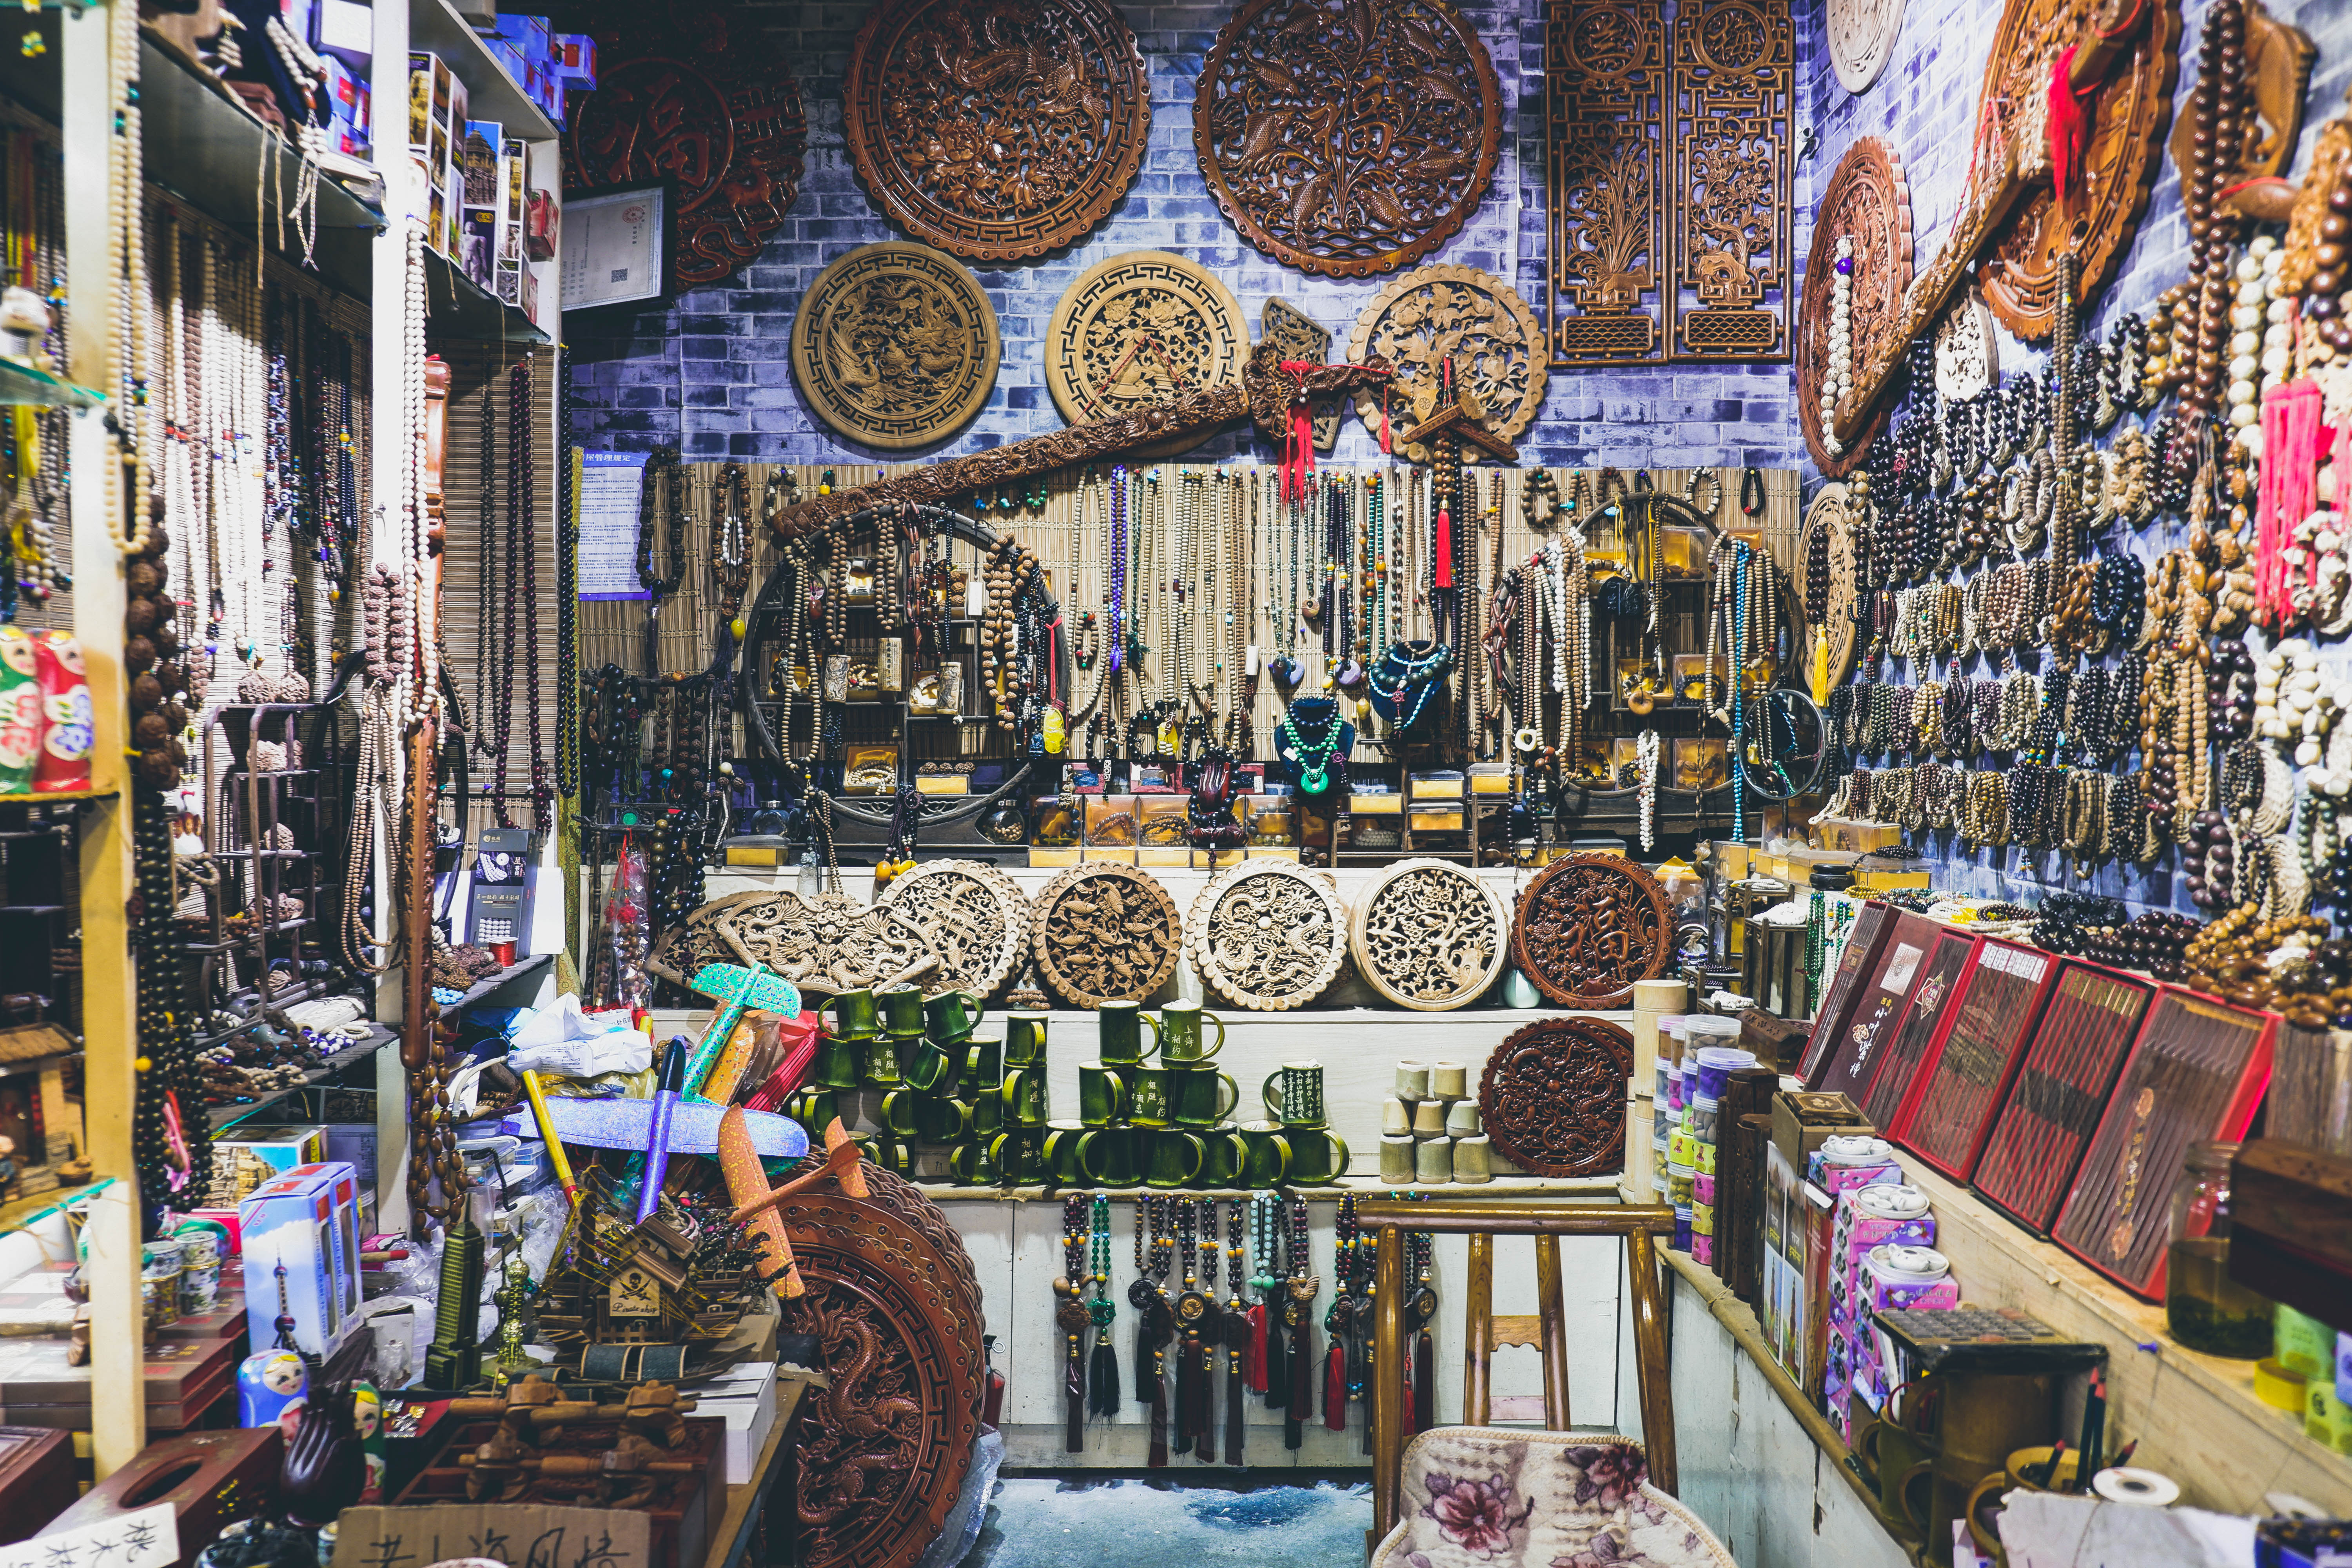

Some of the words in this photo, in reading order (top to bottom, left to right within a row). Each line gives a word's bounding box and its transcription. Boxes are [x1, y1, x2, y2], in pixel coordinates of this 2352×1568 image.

[583, 453, 631, 462] 屋管理规定
